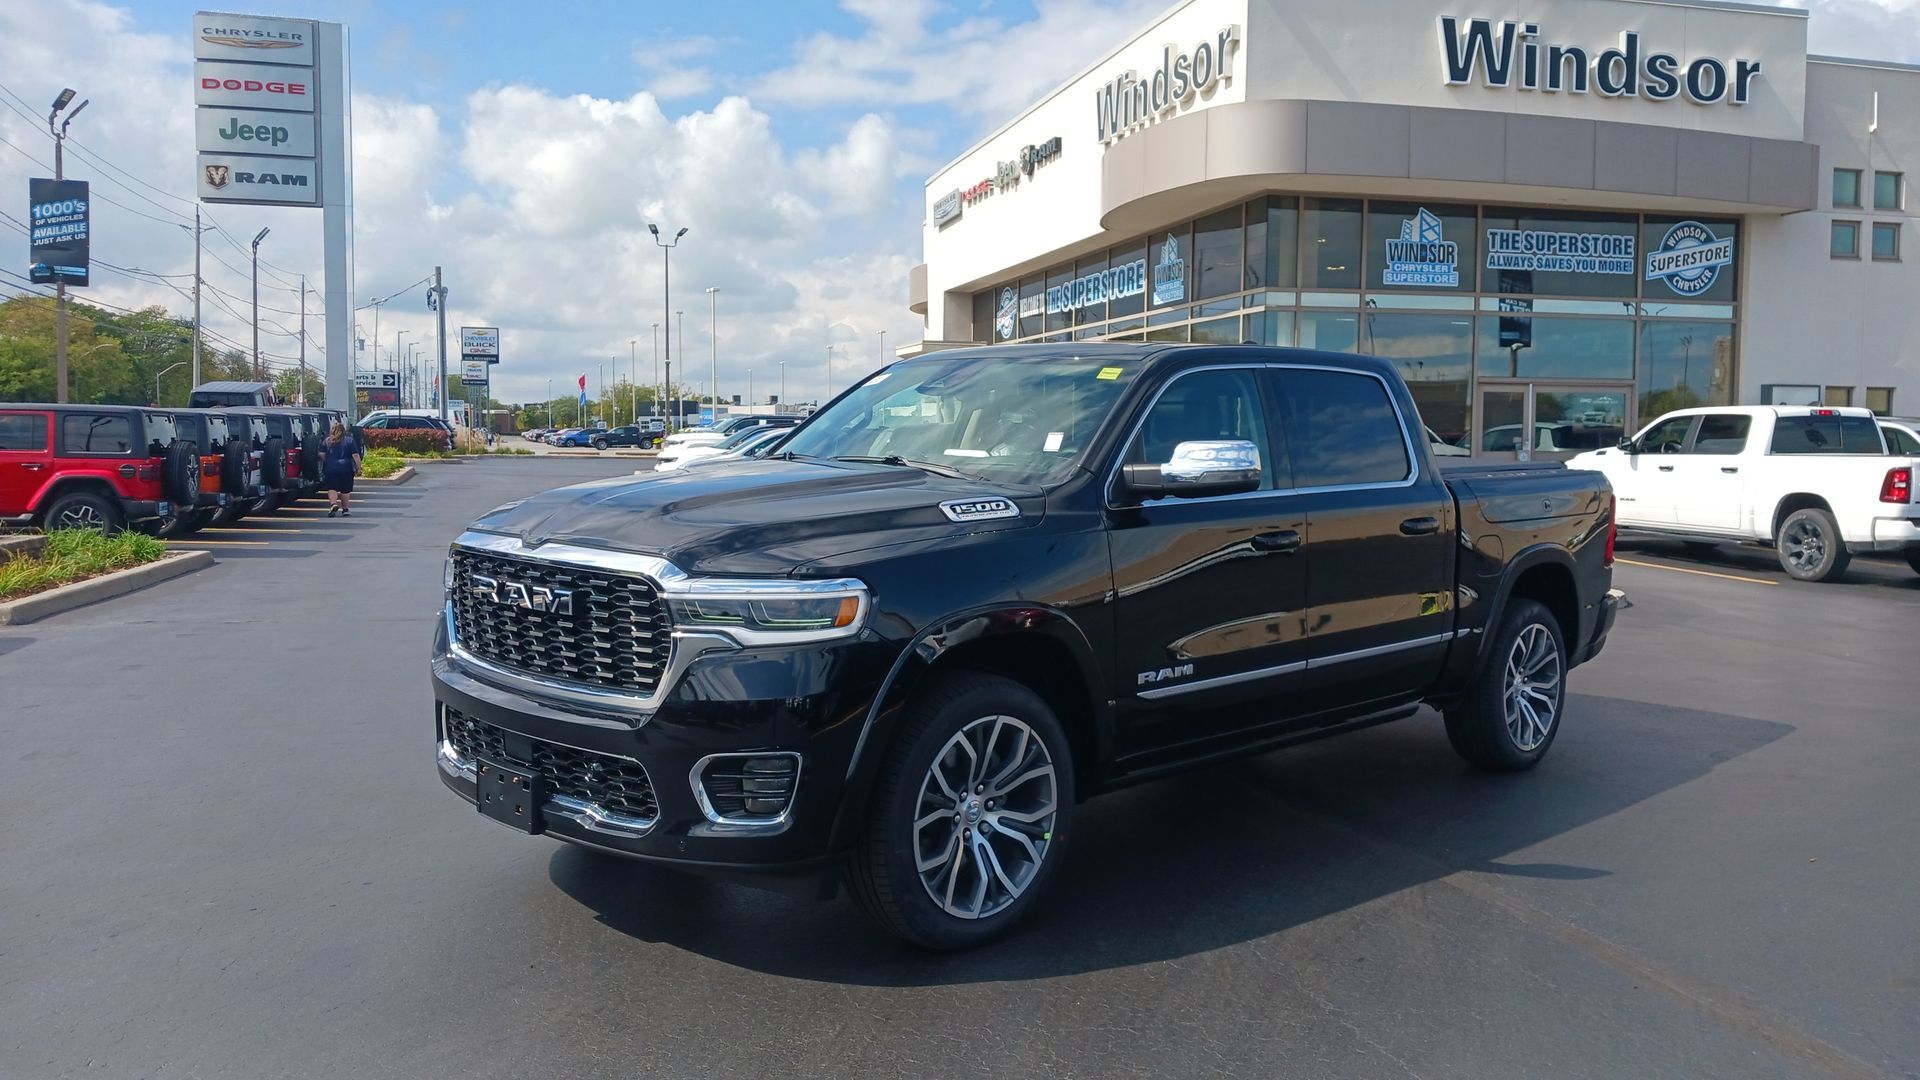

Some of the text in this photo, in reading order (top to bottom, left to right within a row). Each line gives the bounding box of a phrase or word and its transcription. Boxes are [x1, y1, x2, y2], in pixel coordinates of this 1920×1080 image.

[202, 27, 303, 40] CHRYSLER
[1436, 15, 1761, 105] Windsor
[202, 78, 305, 95] DODGE
[1096, 24, 1240, 144] Windsor
[219, 117, 288, 147] Jeep
[235, 172, 308, 186] RAM
[35, 213, 84, 226] OF VEHICLES
[34, 223, 87, 238] AVAILABLE
[34, 237, 54, 246] JUST
[56, 235, 73, 243] ASK
[1667, 227, 1707, 248] WINDSOR
[1388, 242, 1455, 263] WINDSOR
[1489, 231, 1633, 256] THE SUPERSTORE
[1393, 263, 1449, 273] CHRYSLER
[1488, 255, 1632, 272] ALWAYS SAVES YOU MORE!
[1650, 245, 1729, 273] SUPERSTORE
[1047, 287, 1061, 312] THE
[1062, 262, 1145, 309] SUPERSTORE
[1386, 272, 1456, 284] SUPERSTORE
[1672, 269, 1713, 291] CHRYSLER
[951, 501, 1006, 514] 1500
[472, 574, 573, 616] RAM
[1137, 663, 1194, 685] RAM
